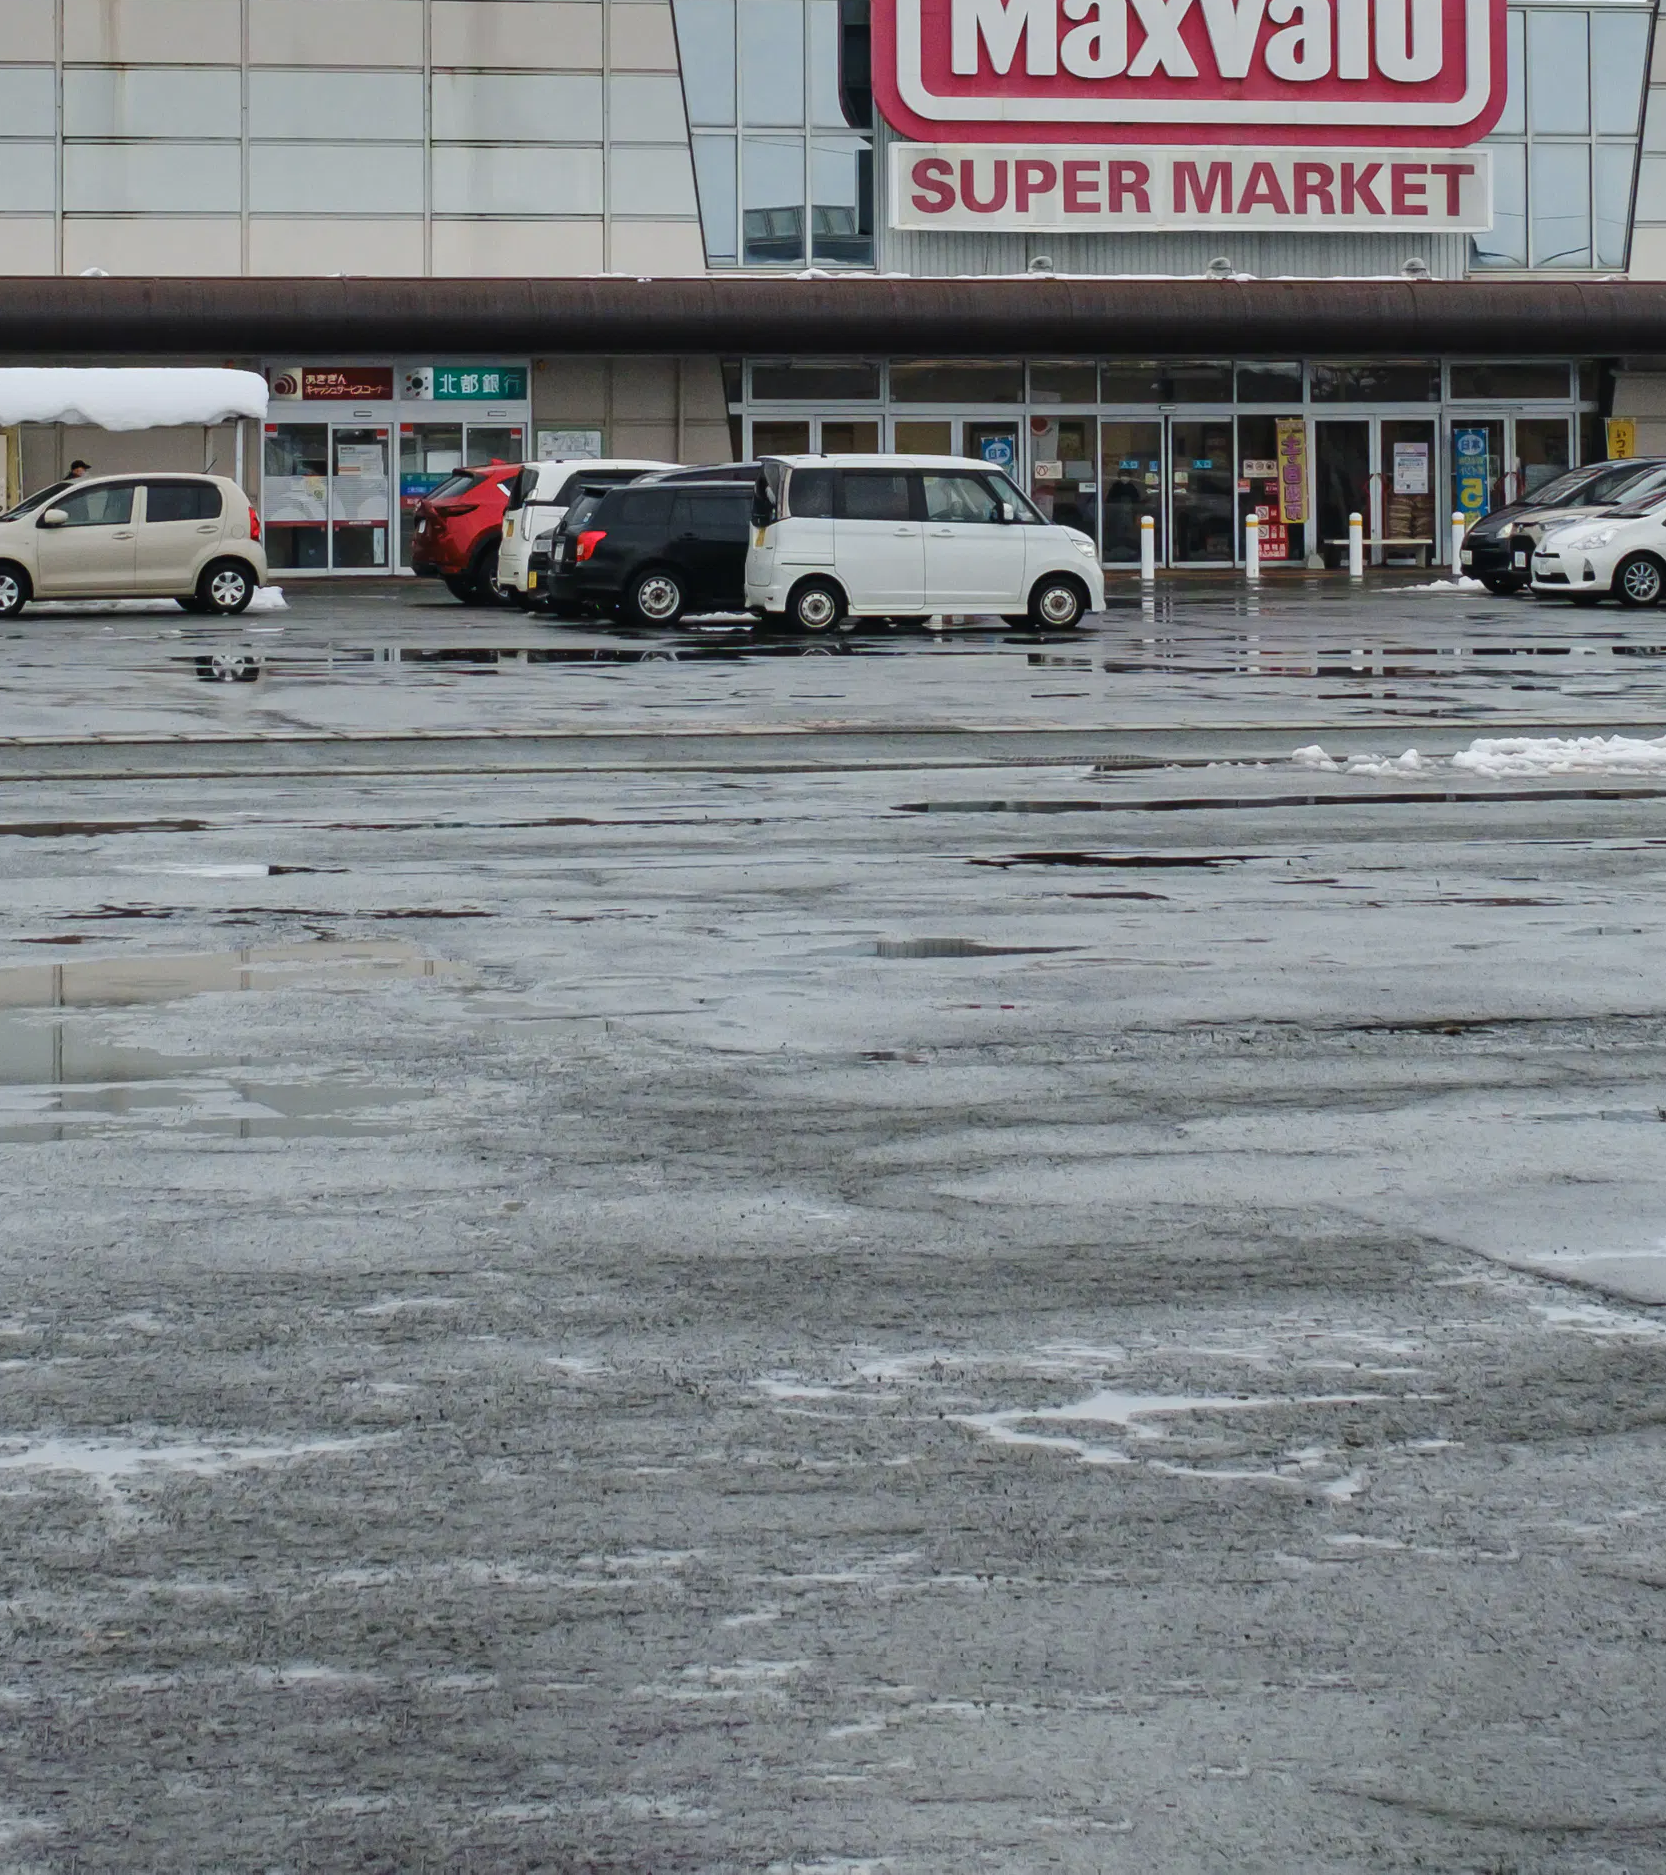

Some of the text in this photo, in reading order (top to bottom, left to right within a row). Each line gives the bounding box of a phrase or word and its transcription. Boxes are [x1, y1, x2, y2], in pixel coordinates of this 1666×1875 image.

[911, 158, 1475, 217] SUPER MARKET
[305, 373, 347, 386] あきぎん
[439, 373, 520, 394] 北都銀行
